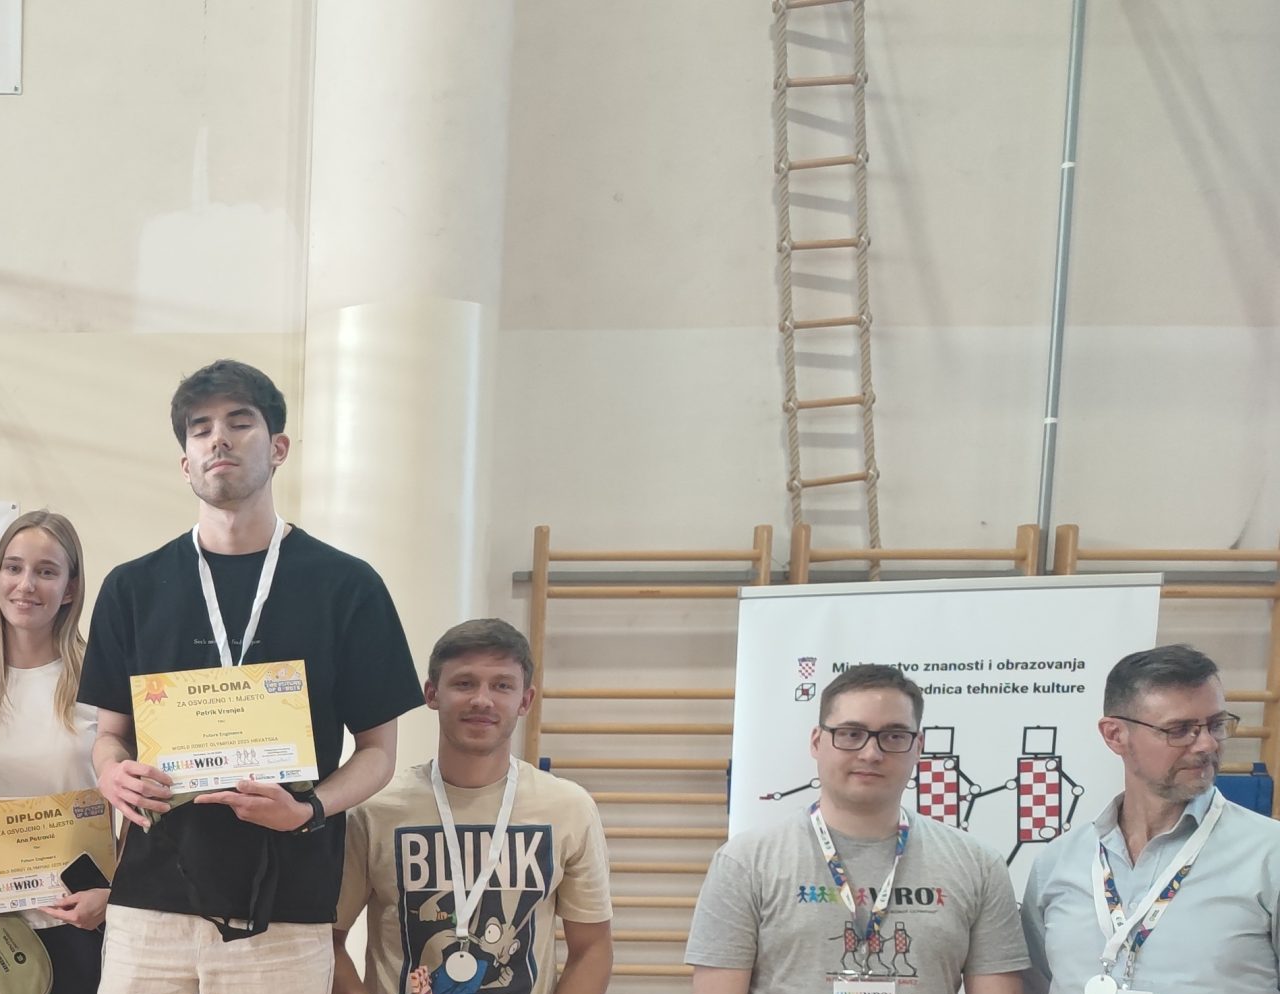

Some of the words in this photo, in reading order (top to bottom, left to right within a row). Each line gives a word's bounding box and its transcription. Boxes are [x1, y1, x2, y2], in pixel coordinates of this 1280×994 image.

[922, 660, 984, 672] znanosti
[988, 659, 993, 671] i
[996, 658, 1086, 673] obrazovanja
[187, 680, 252, 695] DIPLOMA
[919, 682, 963, 695] ednica
[966, 681, 1030, 695] tehničke
[1032, 682, 1086, 694] kulture
[188, 698, 227, 707] OSVOJENO
[235, 694, 265, 703] MJESTO
[194, 755, 223, 769] WRO
[6, 808, 63, 825] DIPLOMA
[7, 825, 41, 835] OSVOJENO
[48, 819, 75, 829] MJESTO
[400, 831, 544, 890] BLINK
[13, 879, 40, 891] WRO
